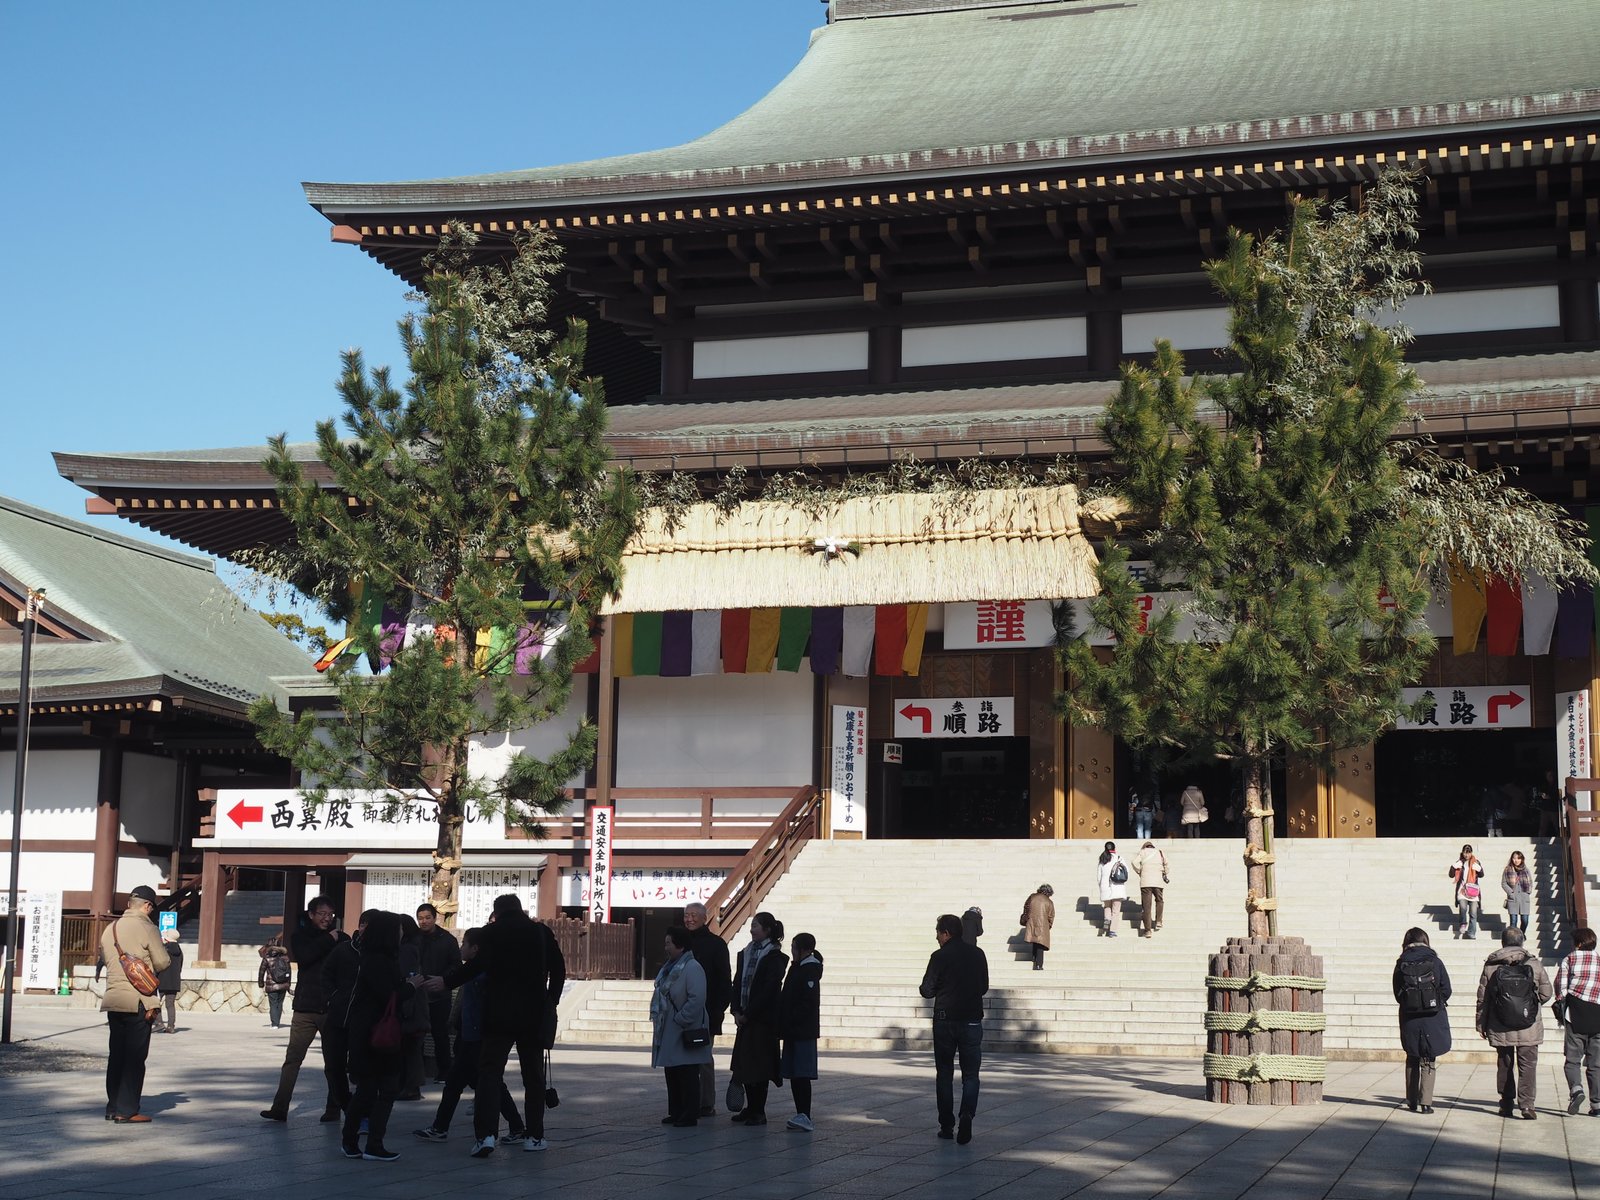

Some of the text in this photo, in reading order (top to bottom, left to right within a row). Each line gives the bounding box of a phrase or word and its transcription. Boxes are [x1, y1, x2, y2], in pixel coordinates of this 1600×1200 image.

[943, 712, 1002, 735] 順路
[593, 811, 608, 923] 交通安全御札所入口
[29, 906, 41, 983] お護摩札お渡し所
